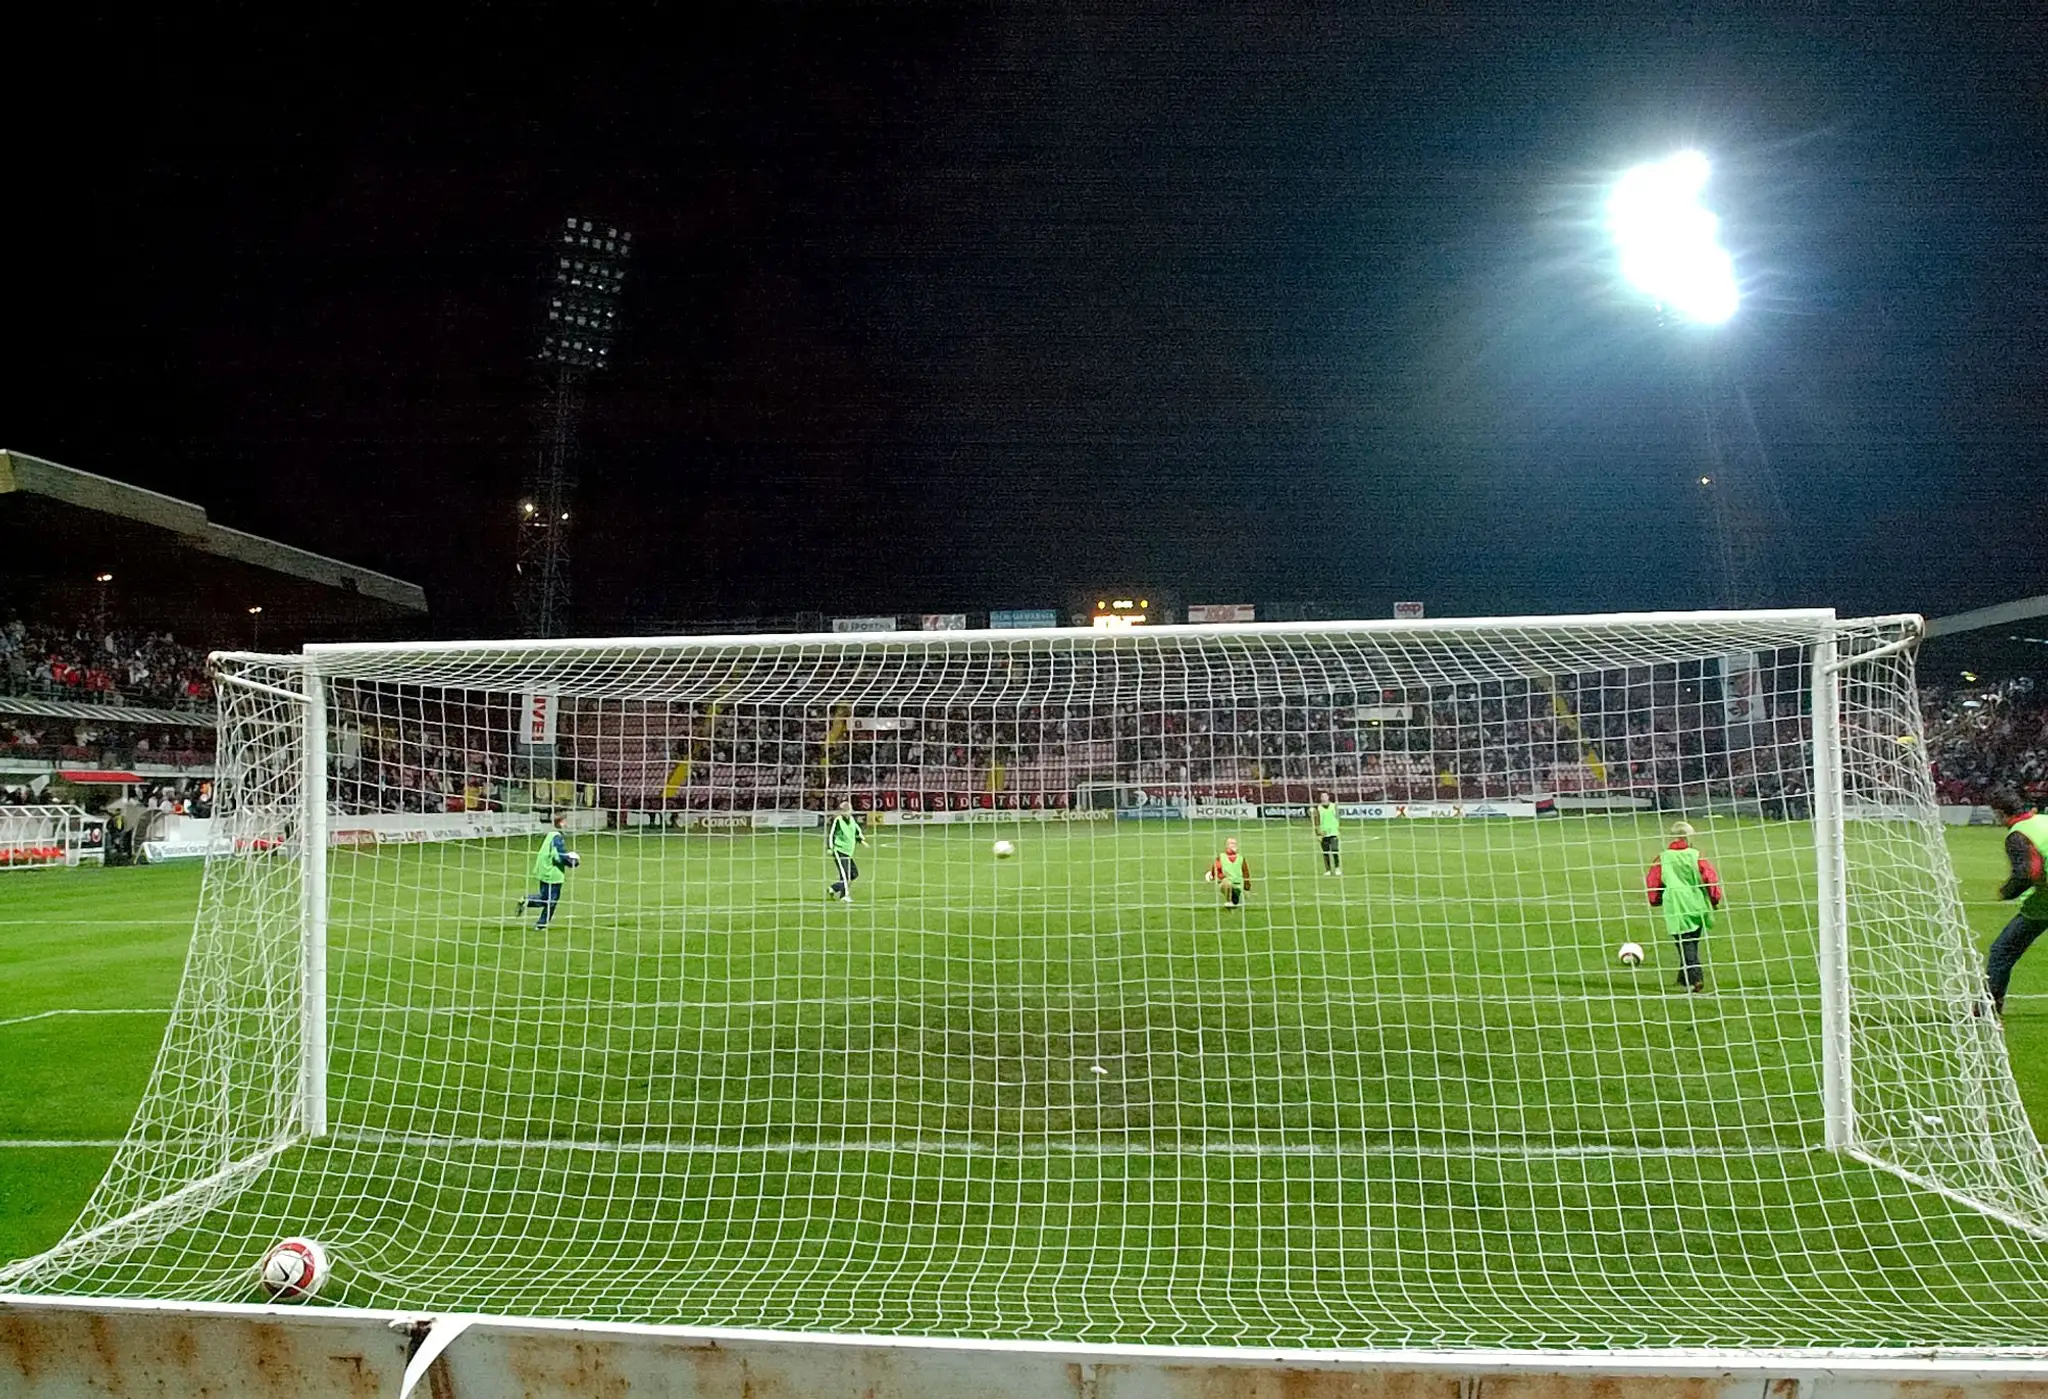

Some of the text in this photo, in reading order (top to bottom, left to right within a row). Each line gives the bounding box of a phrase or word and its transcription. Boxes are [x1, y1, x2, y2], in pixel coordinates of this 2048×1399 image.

[935, 796, 981, 808] SIDE
[996, 794, 1068, 807] TRNAVA
[1339, 807, 1383, 816] BLANCO
